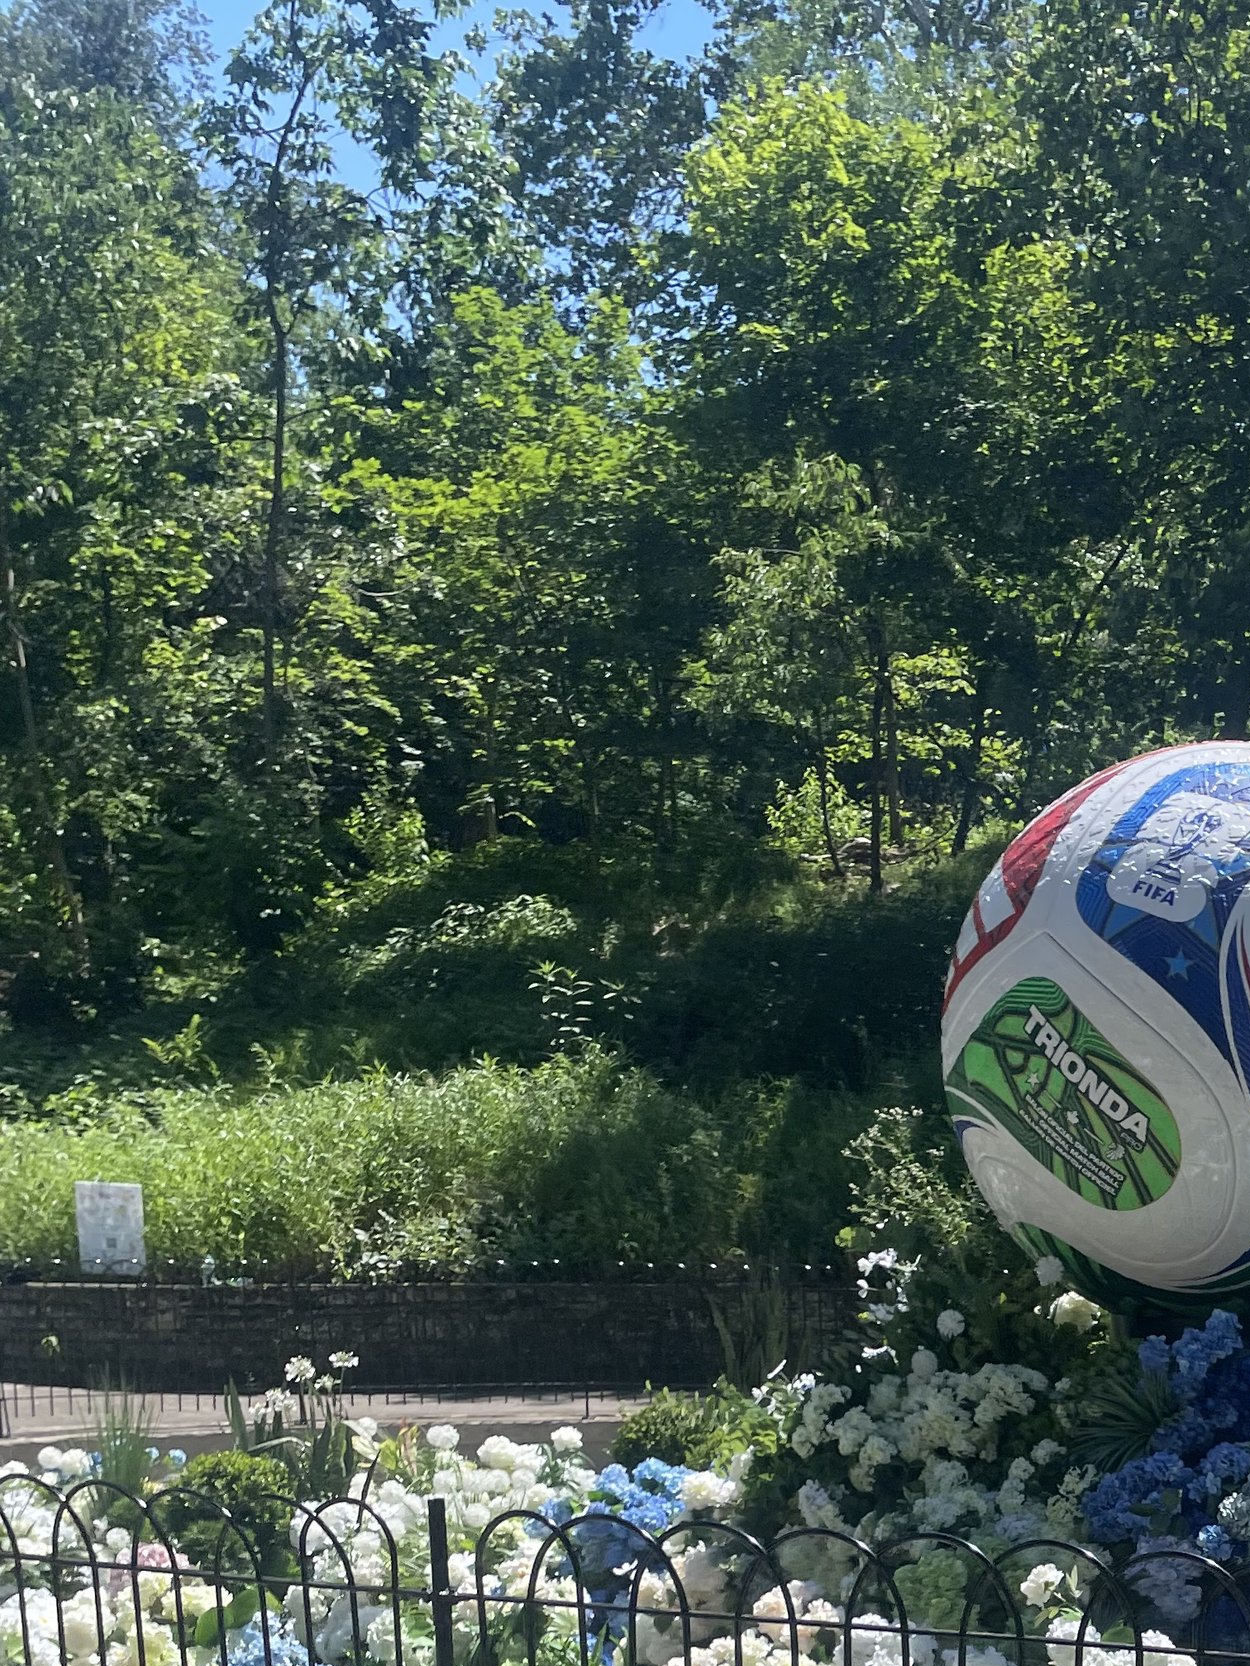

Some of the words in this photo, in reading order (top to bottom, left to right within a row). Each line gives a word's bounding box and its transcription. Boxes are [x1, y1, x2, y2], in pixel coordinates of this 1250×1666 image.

[1132, 880, 1175, 906] FIFA
[1024, 1004, 1149, 1143] TRIONDA
[1070, 1149, 1099, 1174] MATCH
[1089, 1153, 1124, 1181] PARTIDO
